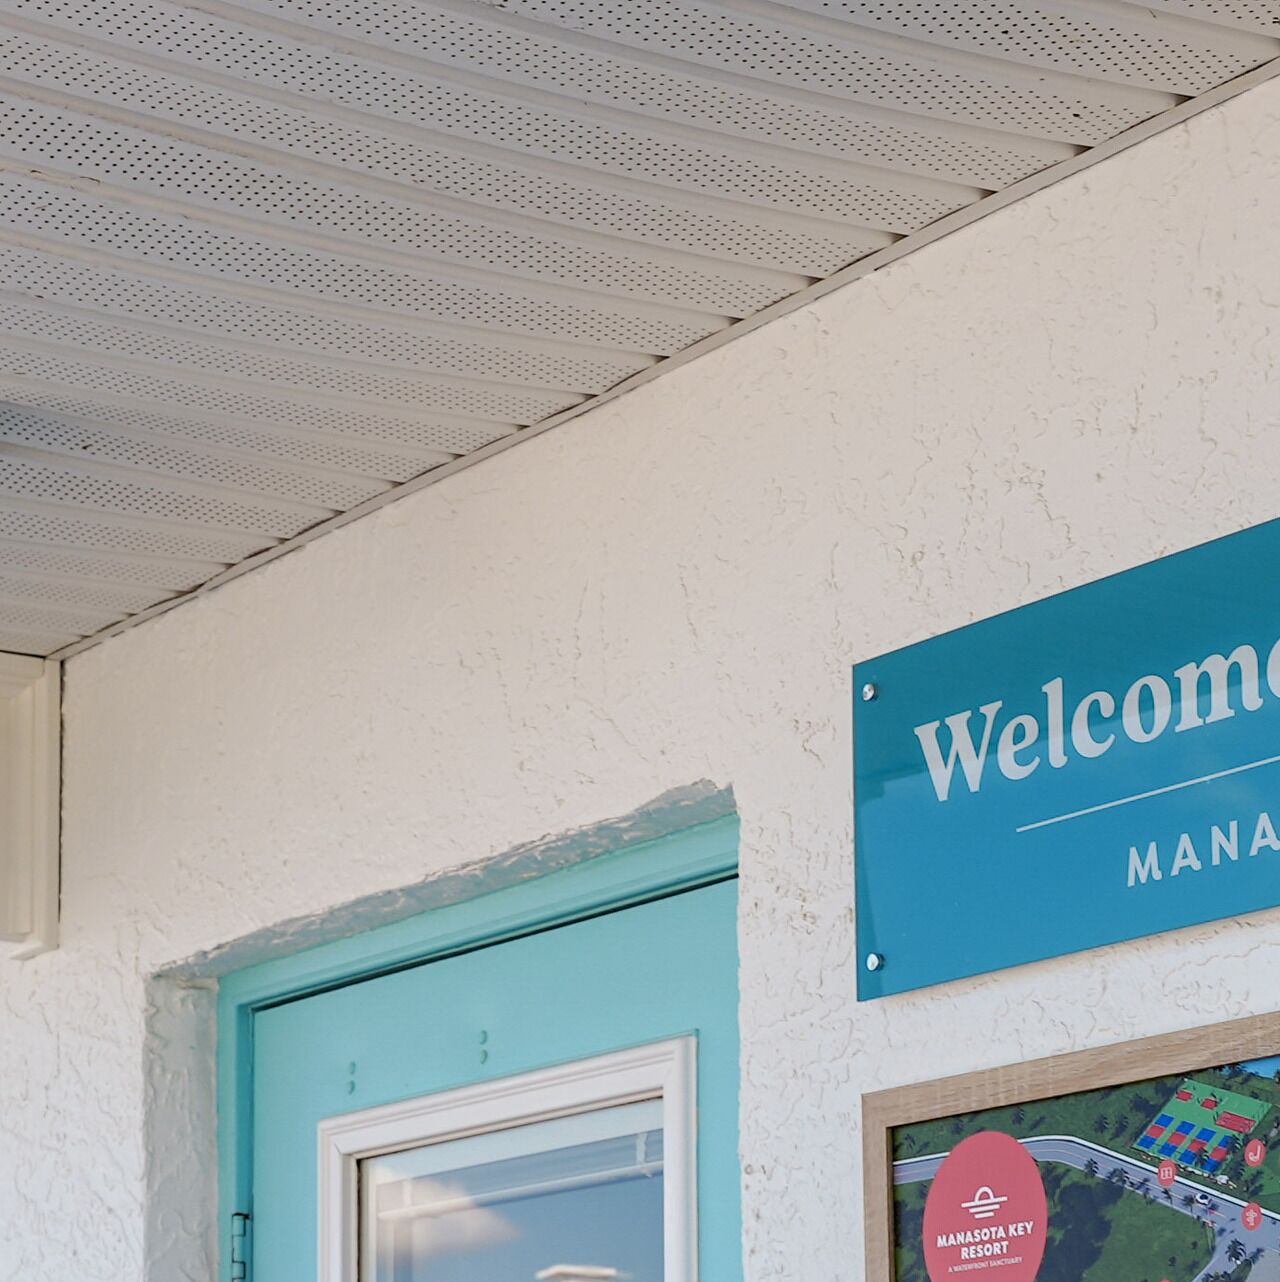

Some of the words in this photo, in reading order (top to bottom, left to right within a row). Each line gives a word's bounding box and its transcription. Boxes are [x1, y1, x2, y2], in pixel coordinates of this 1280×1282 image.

[936, 1225, 1007, 1249] MANASOTA
[1008, 1220, 1034, 1238] KEY
[961, 1240, 1009, 1260] RESORT
